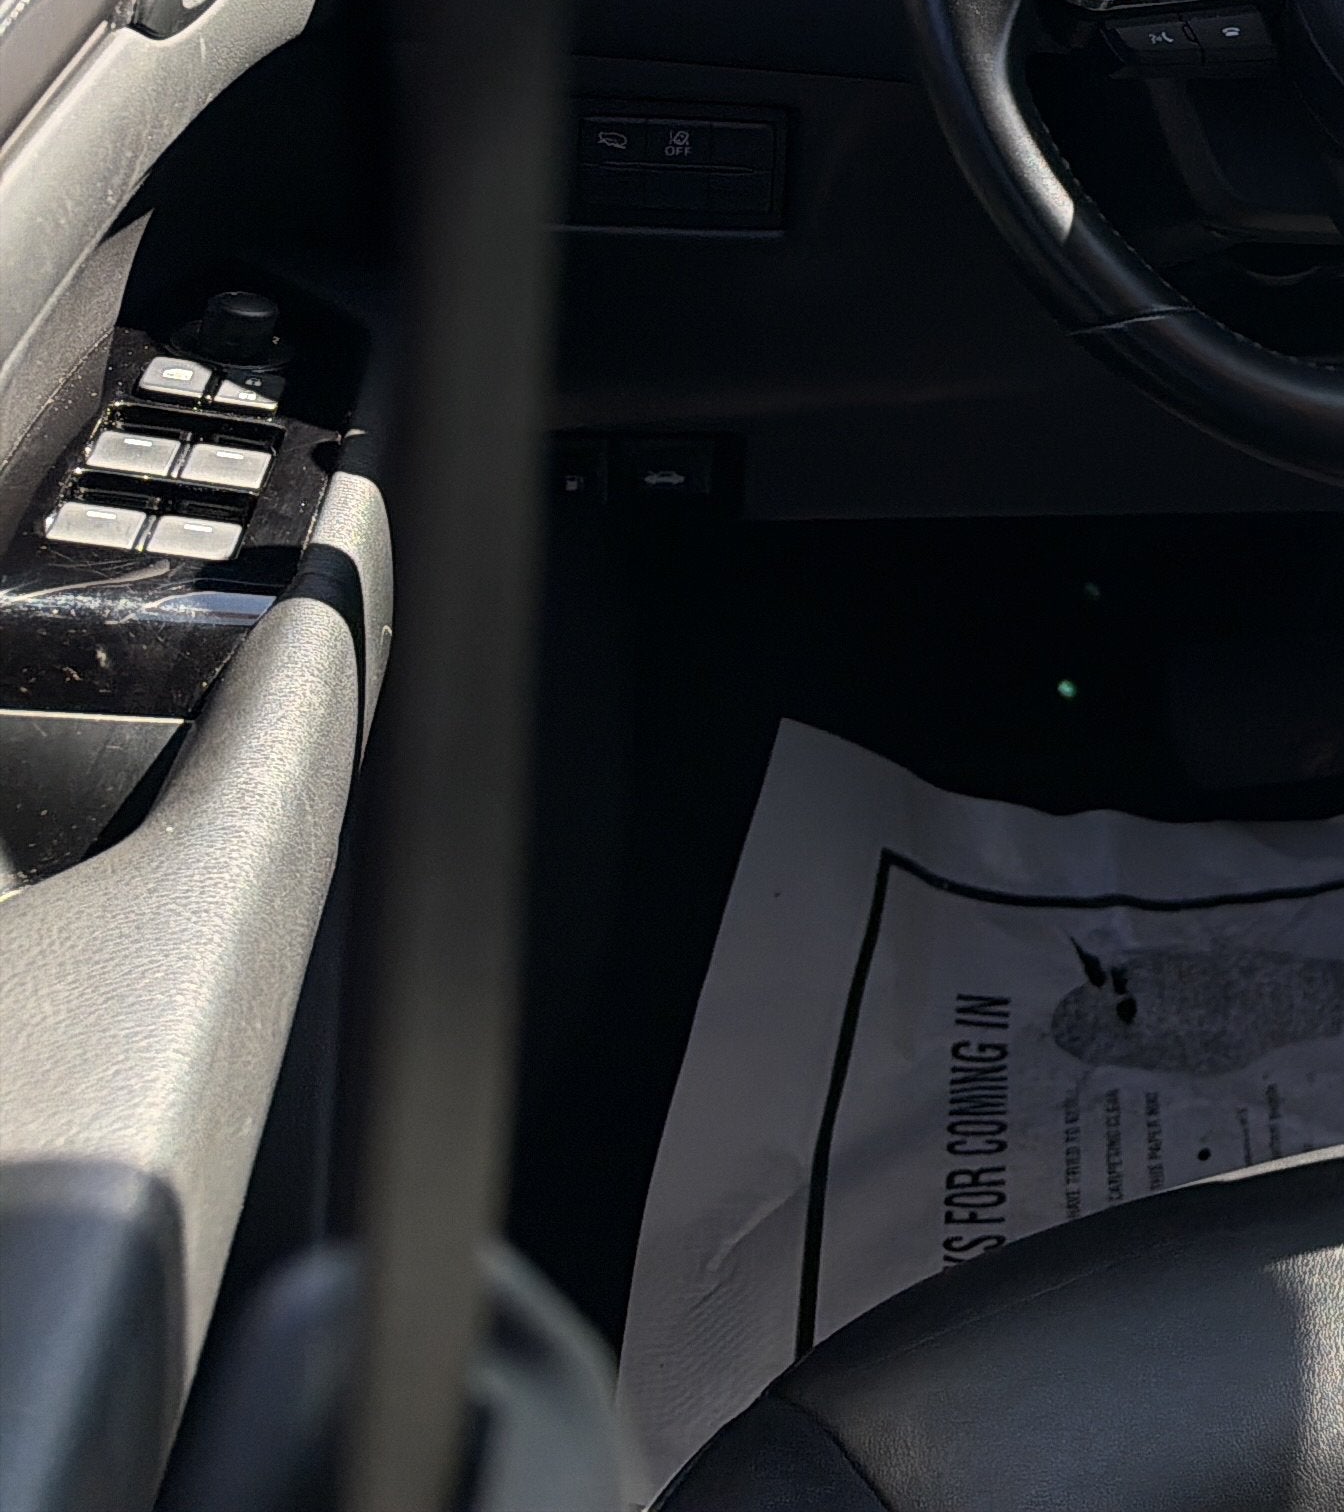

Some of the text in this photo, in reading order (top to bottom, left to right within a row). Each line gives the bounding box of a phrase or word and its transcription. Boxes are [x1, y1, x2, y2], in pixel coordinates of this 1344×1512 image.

[664, 145, 692, 156] OFF
[955, 993, 1011, 1029] IN
[946, 1040, 1009, 1156] COMING
[944, 1166, 1006, 1224] FOR
